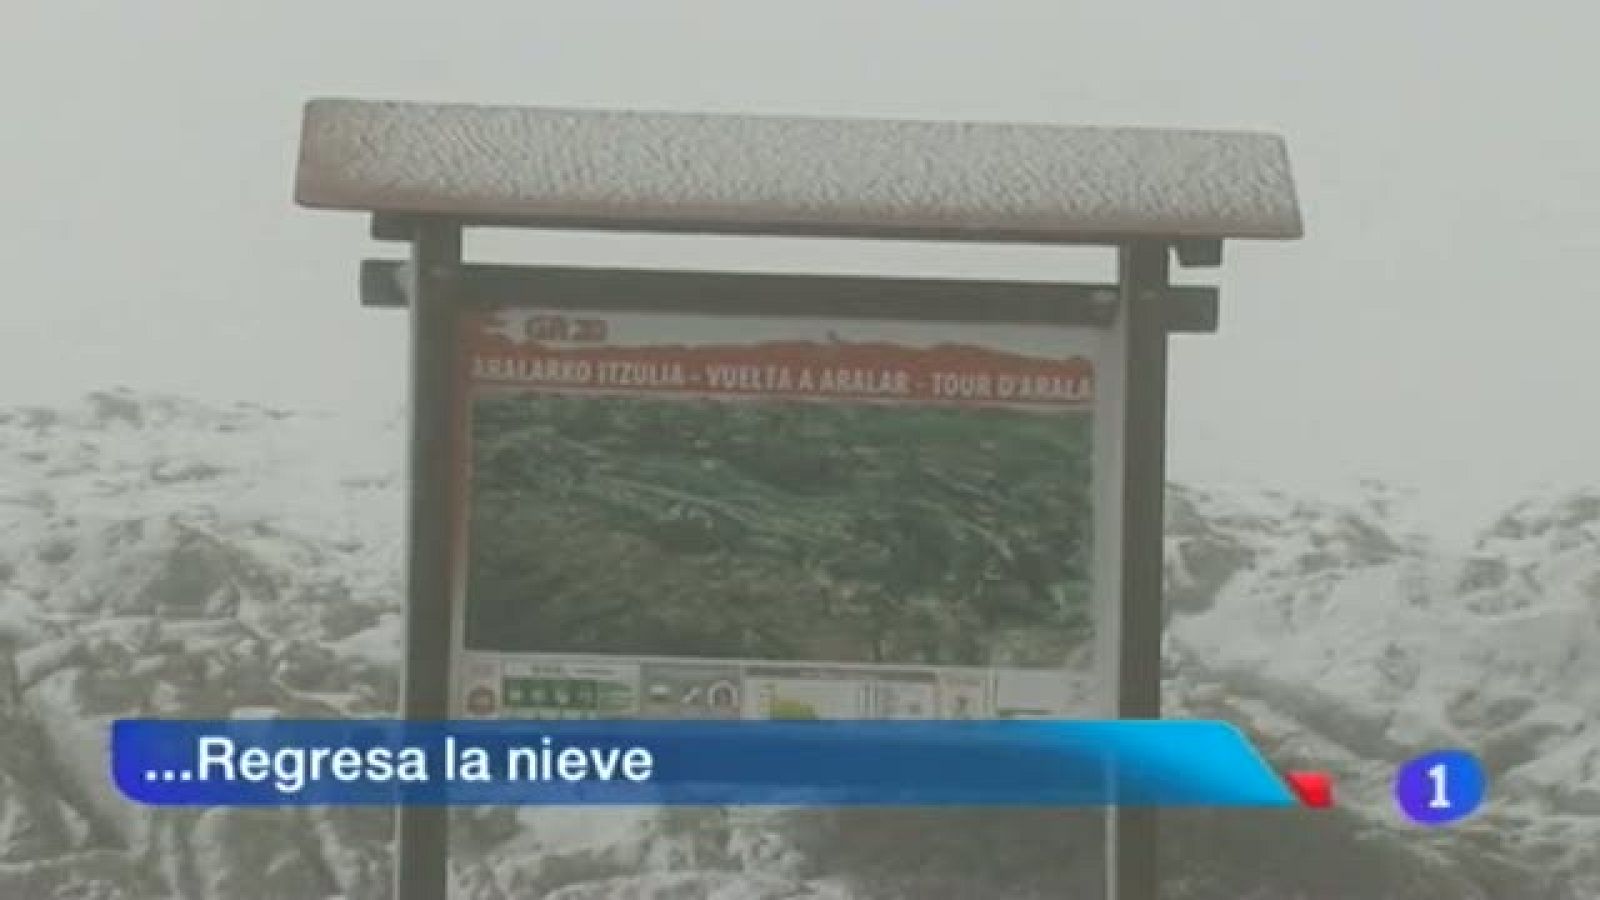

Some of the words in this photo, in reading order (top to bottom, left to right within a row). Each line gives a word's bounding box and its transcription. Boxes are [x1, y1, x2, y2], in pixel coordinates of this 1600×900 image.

[705, 363, 792, 391] VUELTA
[799, 367, 813, 392] A
[819, 368, 911, 395] ARALAR
[931, 372, 991, 398] TOUR
